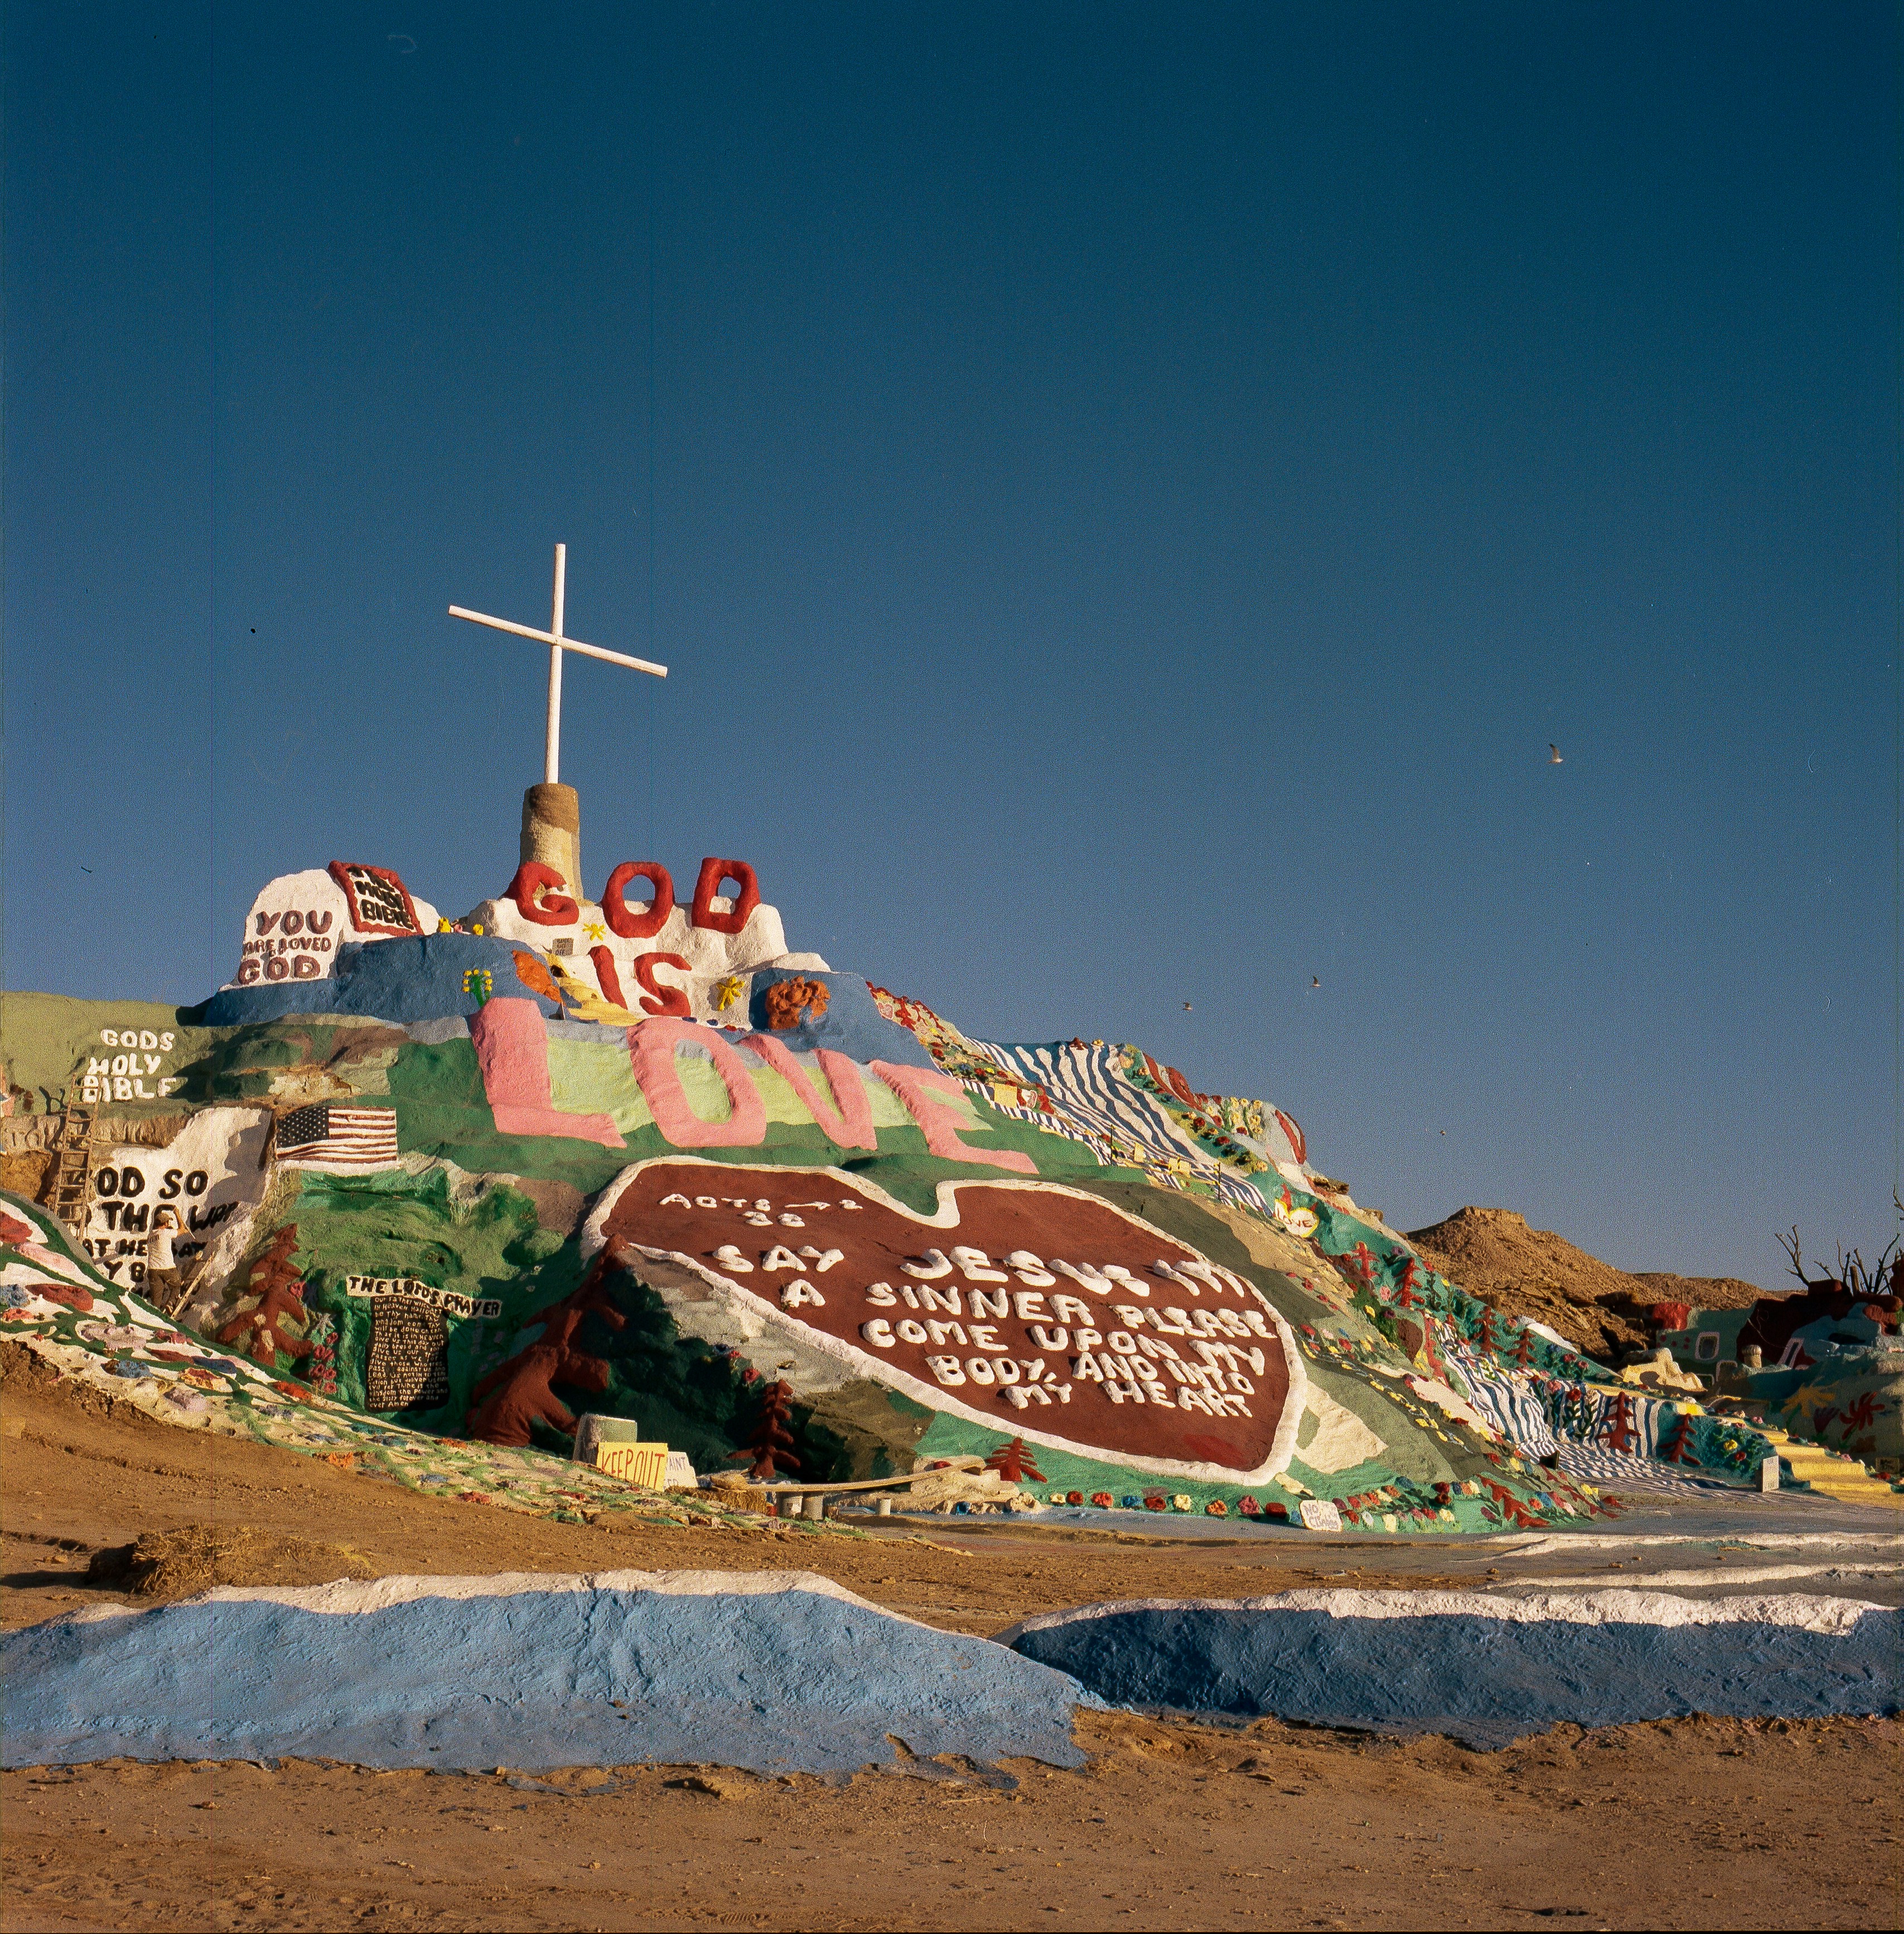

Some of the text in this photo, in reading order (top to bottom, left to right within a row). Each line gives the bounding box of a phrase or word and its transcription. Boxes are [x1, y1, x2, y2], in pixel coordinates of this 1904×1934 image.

[506, 857, 760, 939] GOD
[256, 910, 332, 936] YOU
[243, 937, 331, 955] ARE LOVED
[238, 955, 321, 985] GOD
[588, 945, 692, 1017] IS
[100, 1028, 175, 1052] GODS
[470, 997, 1038, 1174] LOVE
[160, 1169, 209, 1199] SO
[1277, 1207, 1313, 1228] LOVE
[712, 1245, 845, 1273] SAY
[349, 1276, 388, 1294] THE
[444, 1293, 501, 1317] PRAYER
[781, 1279, 1278, 1338] A SINNER PLEASE
[863, 1318, 1265, 1376] COME UPON MY
[1072, 1352, 1158, 1382] AND
[1162, 1359, 1255, 1395] INTO
[1005, 1381, 1253, 1418] MY HEART
[601, 1449, 665, 1490] KEEP OUT
[666, 1456, 686, 1472] AINT
[1303, 1503, 1319, 1516] NO
